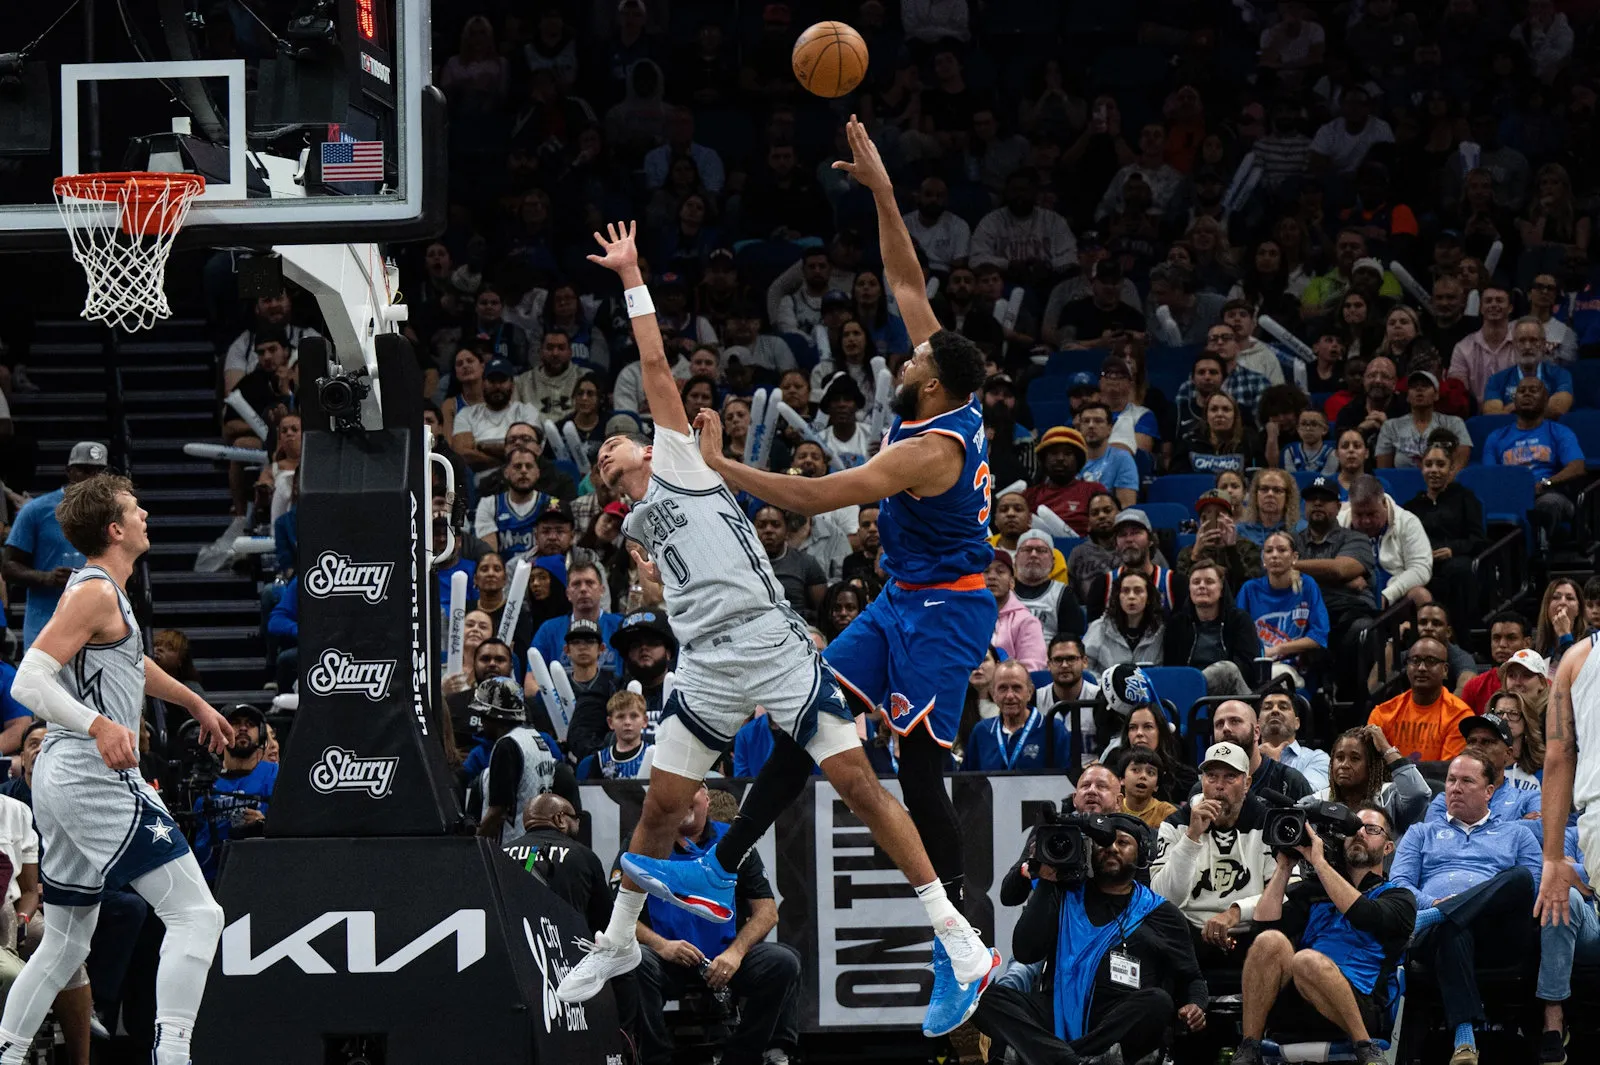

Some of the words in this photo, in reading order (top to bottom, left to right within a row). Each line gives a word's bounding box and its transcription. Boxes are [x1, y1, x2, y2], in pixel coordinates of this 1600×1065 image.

[308, 554, 390, 601] Starry
[667, 544, 690, 588] 0
[312, 651, 393, 698] Starry
[313, 748, 394, 796] Starry
[541, 917, 563, 958] City
[835, 926, 935, 1008] ON
[563, 1001, 588, 1031] Bank
